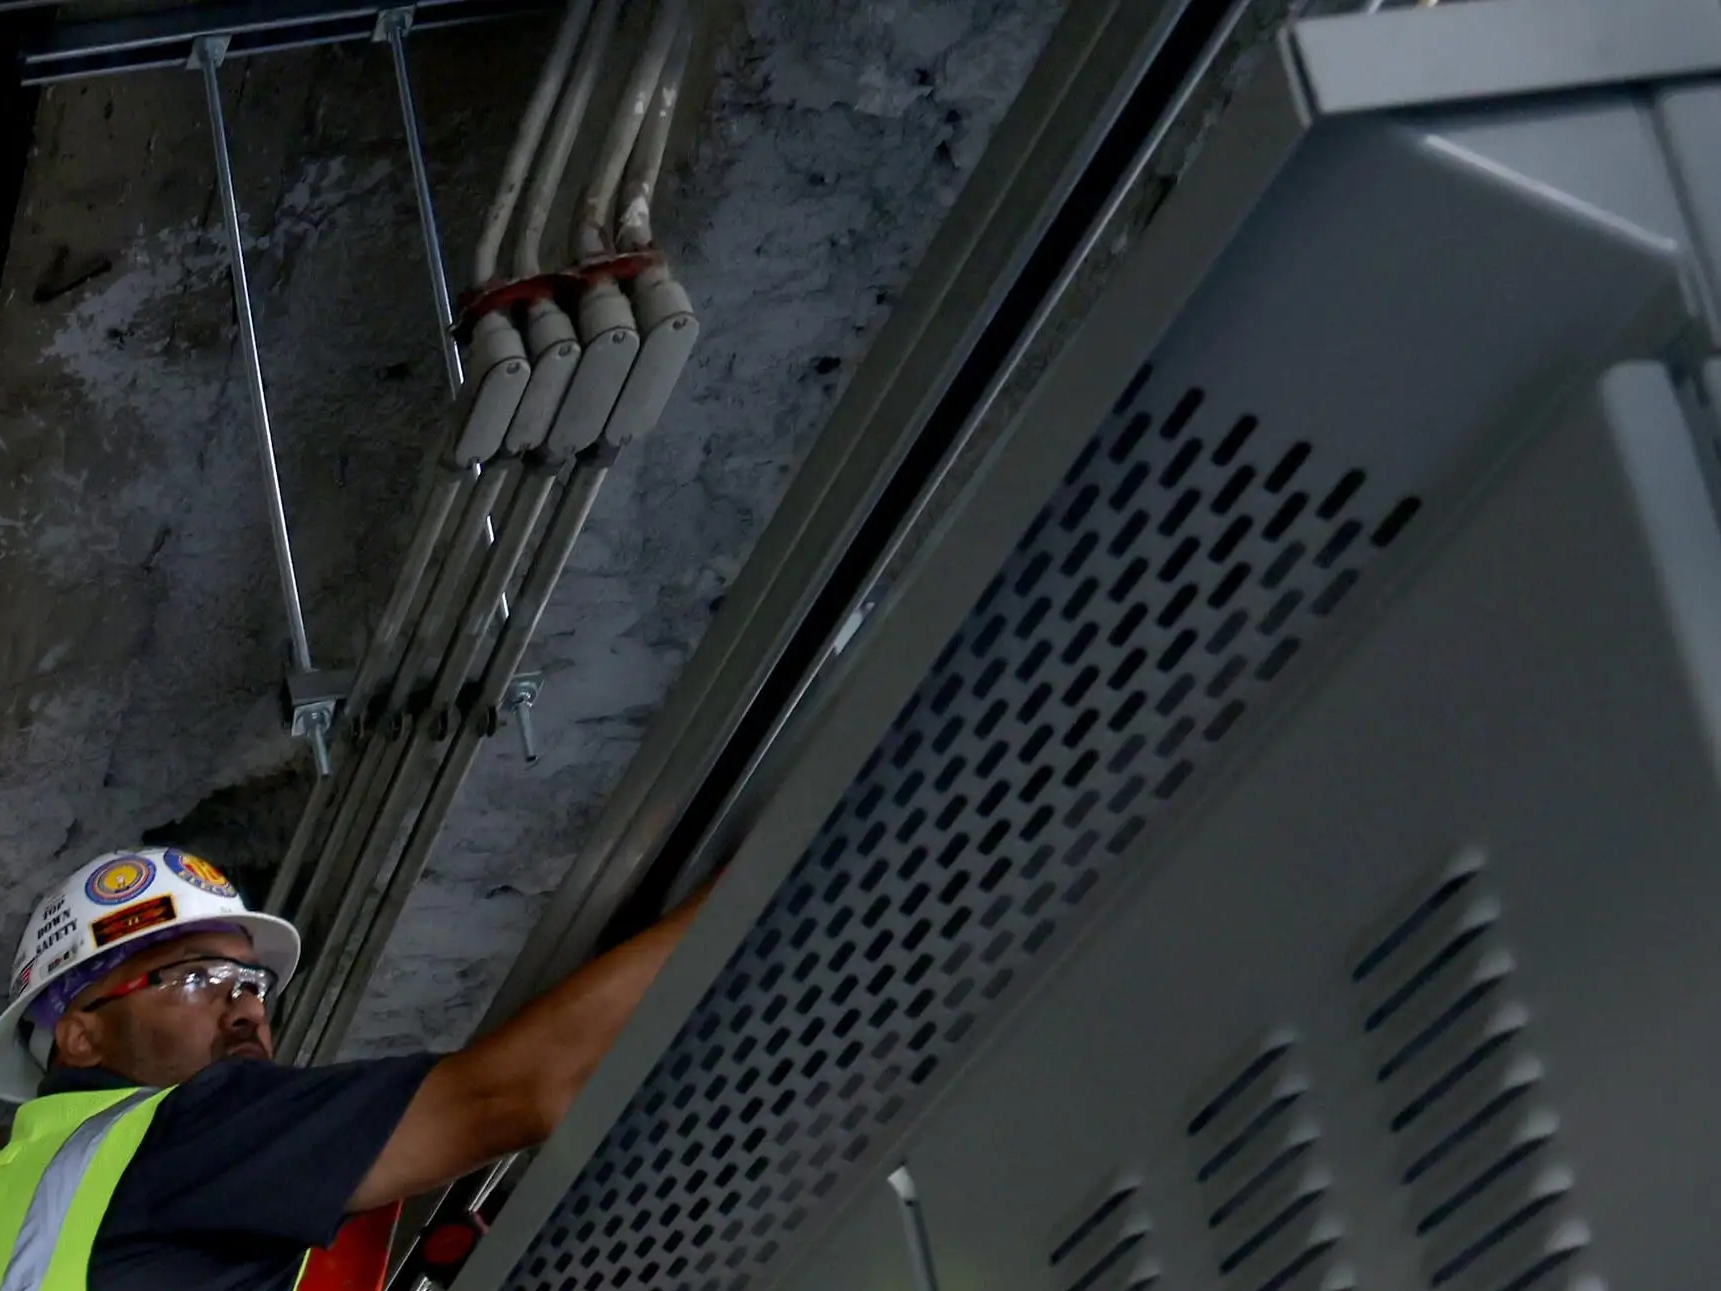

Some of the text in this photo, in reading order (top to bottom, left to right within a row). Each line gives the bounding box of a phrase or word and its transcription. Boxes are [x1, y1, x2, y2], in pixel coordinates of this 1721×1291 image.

[37, 908, 71, 940] DOWN
[43, 900, 66, 920] TOP
[35, 918, 79, 956] SAFETY
